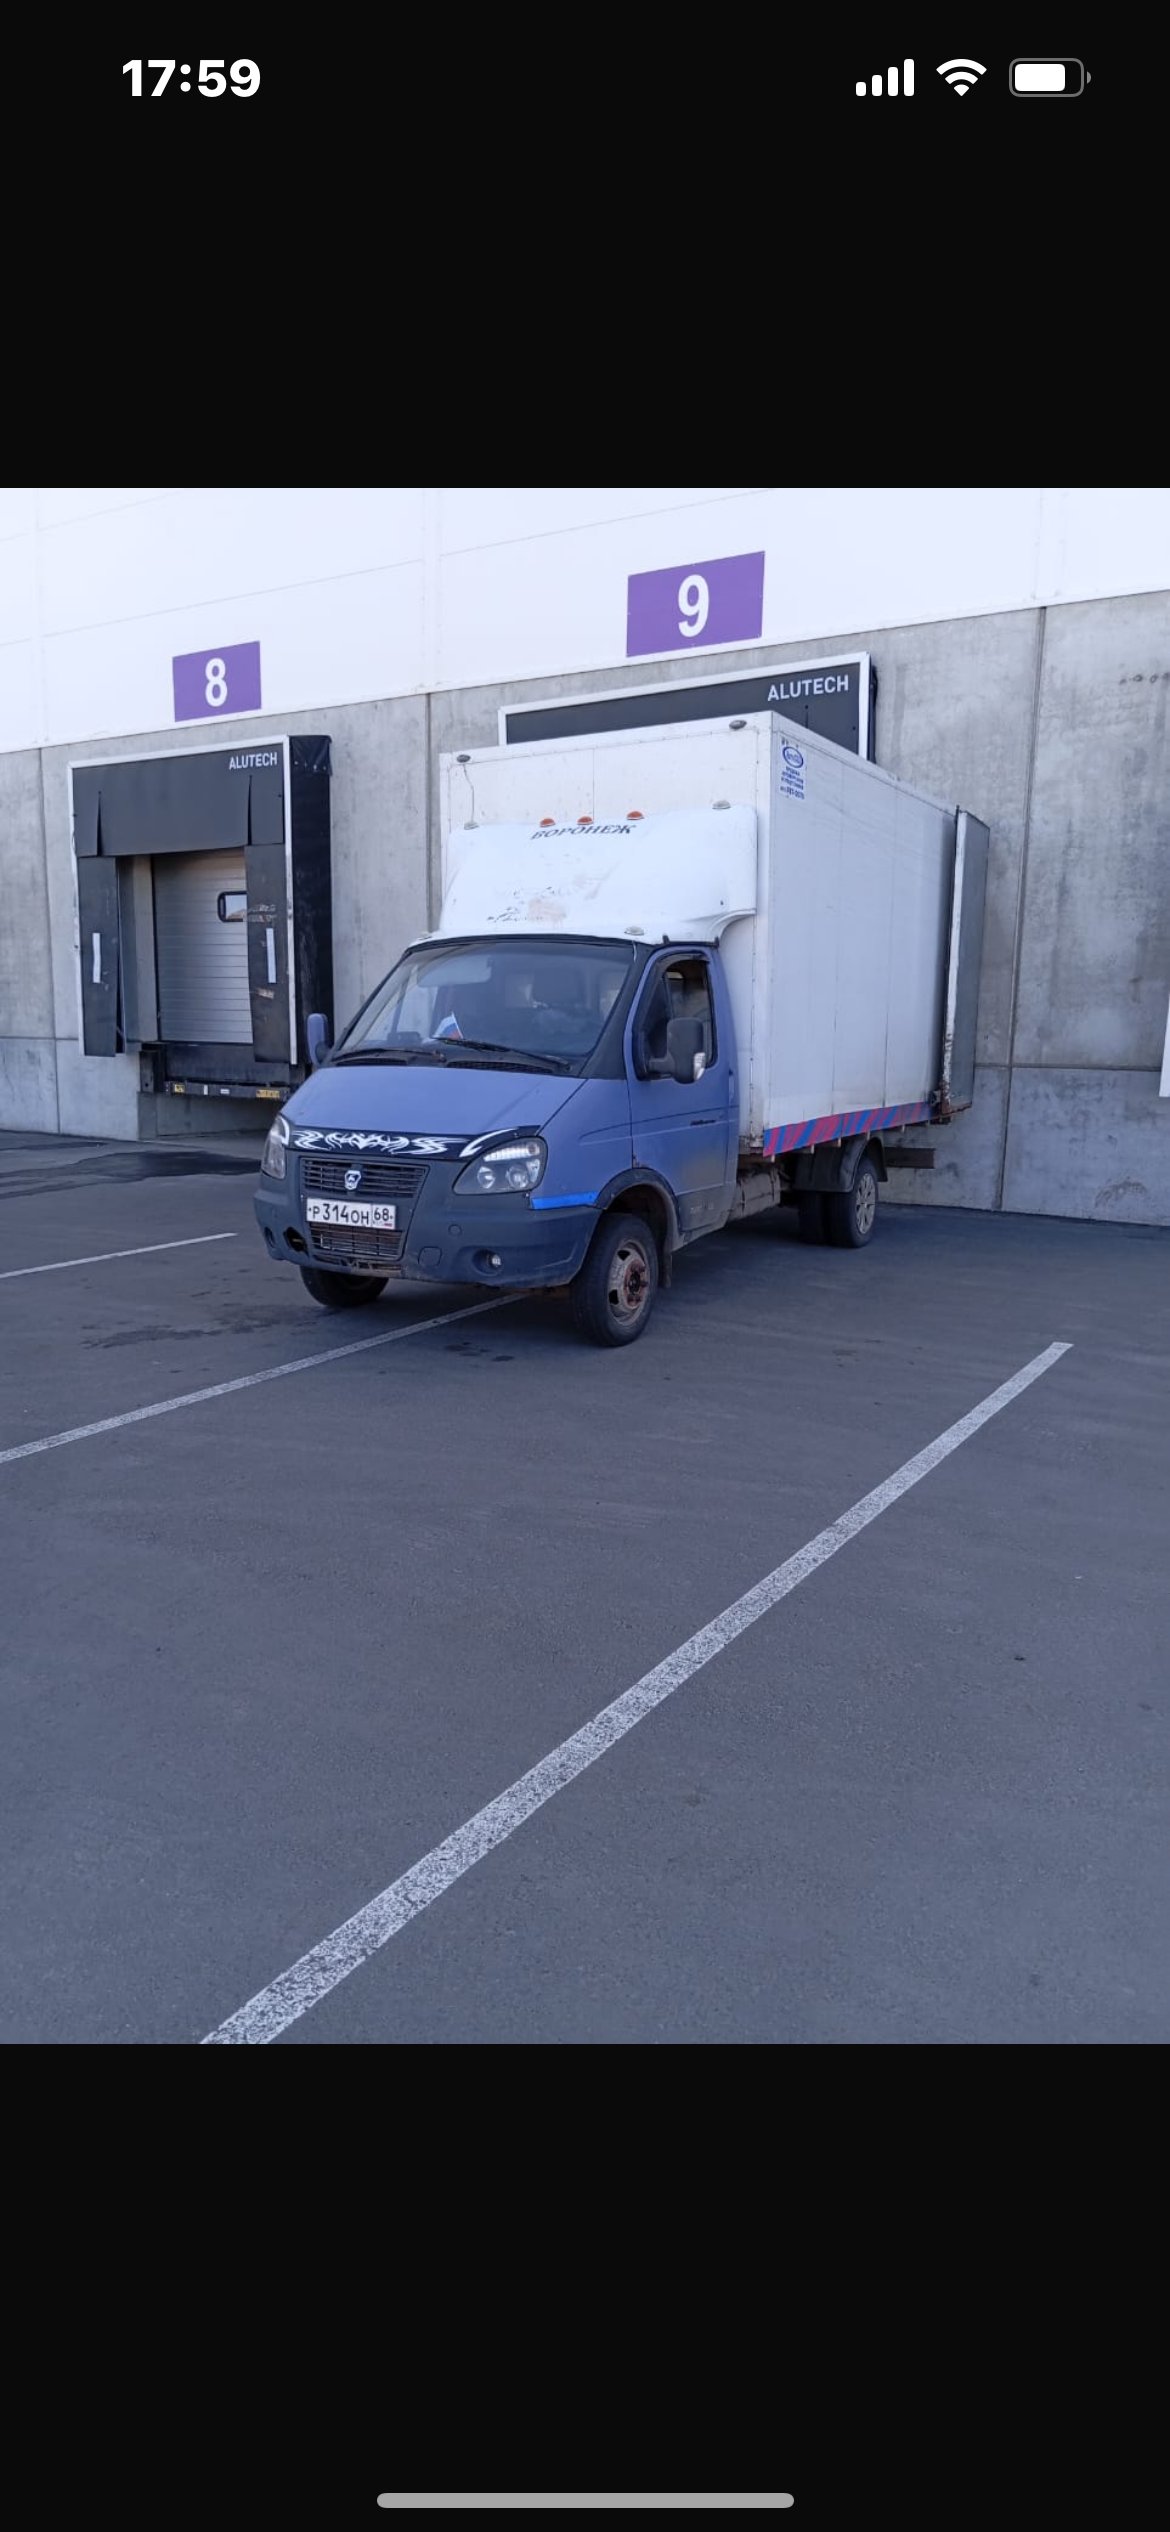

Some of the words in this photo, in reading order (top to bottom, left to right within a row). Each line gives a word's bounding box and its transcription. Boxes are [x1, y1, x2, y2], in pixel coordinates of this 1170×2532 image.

[678, 574, 709, 637] 9
[205, 658, 228, 707] 8
[767, 674, 849, 702] ALUTECH
[229, 751, 278, 770] ALUTECH
[530, 824, 636, 840] ВОРОНЕЖ
